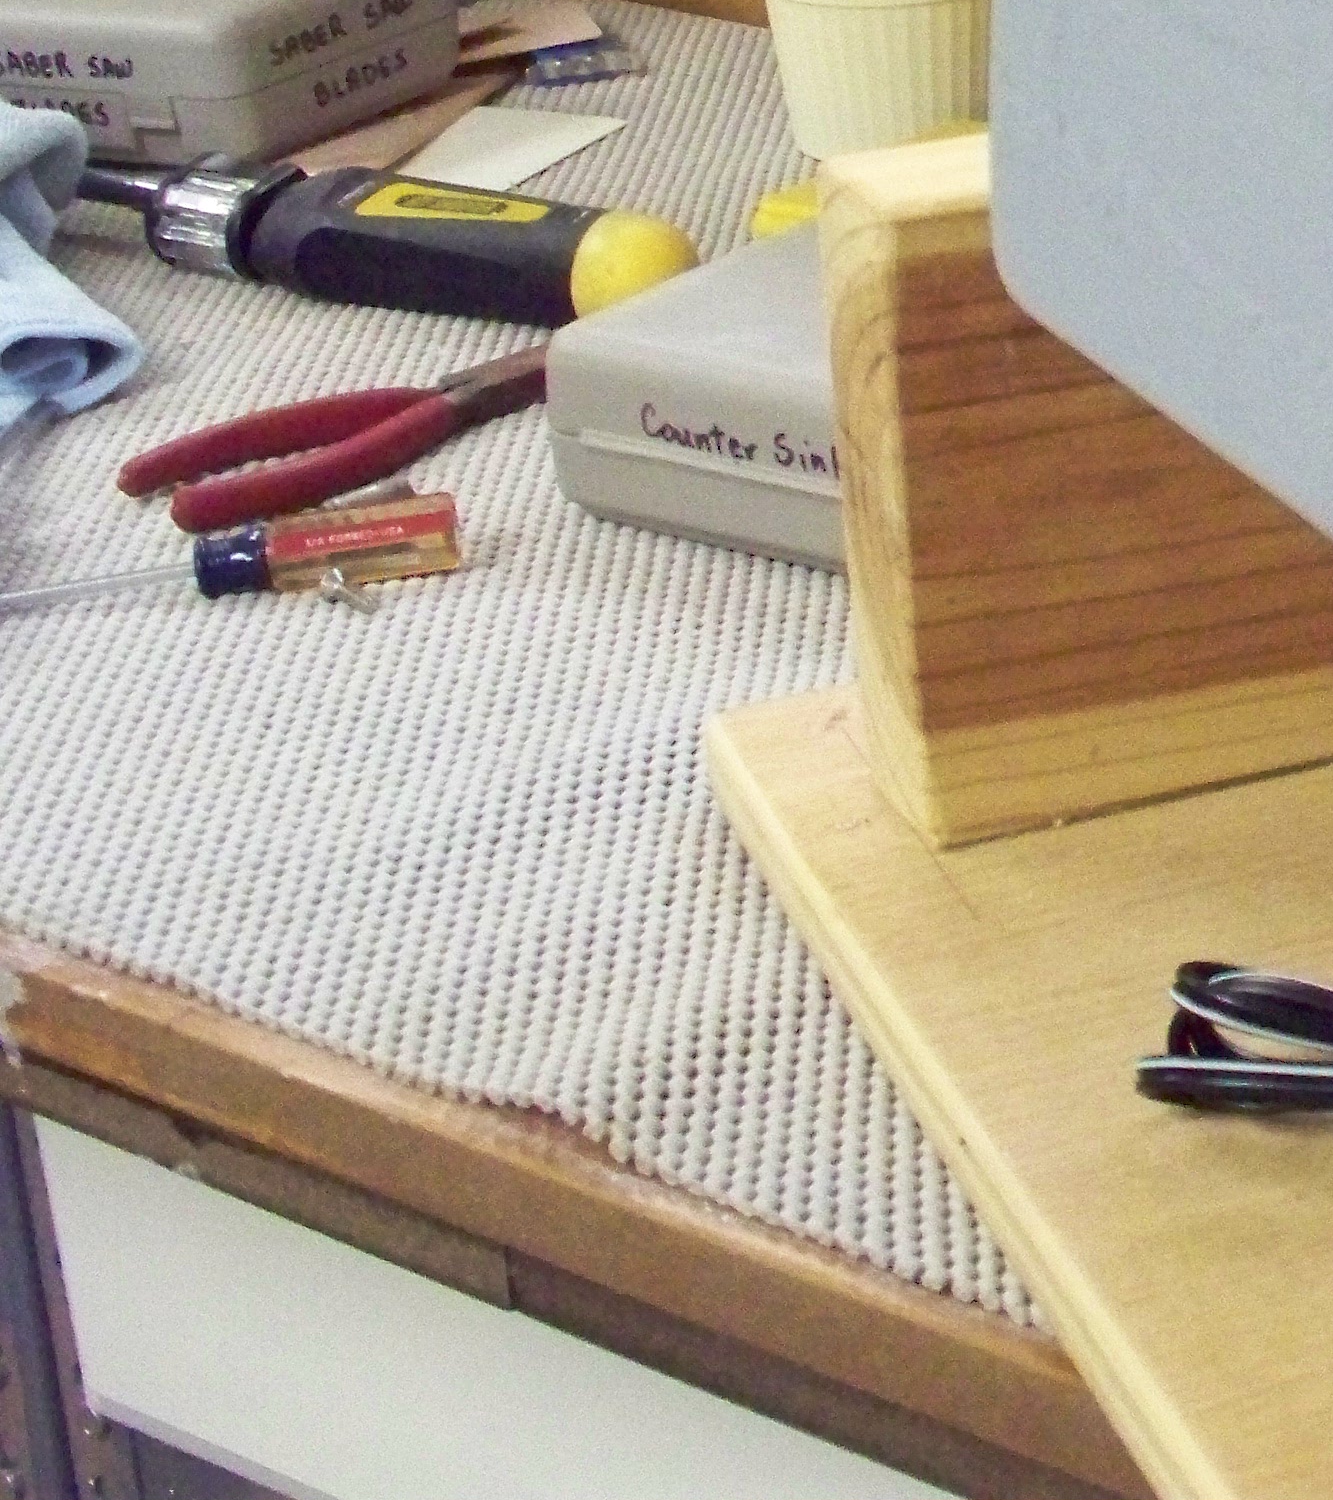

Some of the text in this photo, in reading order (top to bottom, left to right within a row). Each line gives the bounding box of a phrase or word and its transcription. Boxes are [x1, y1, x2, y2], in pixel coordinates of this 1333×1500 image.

[87, 53, 133, 79] SAW
[268, 12, 348, 66] SABER
[314, 48, 407, 108] BLADES
[640, 402, 758, 461] Counter
